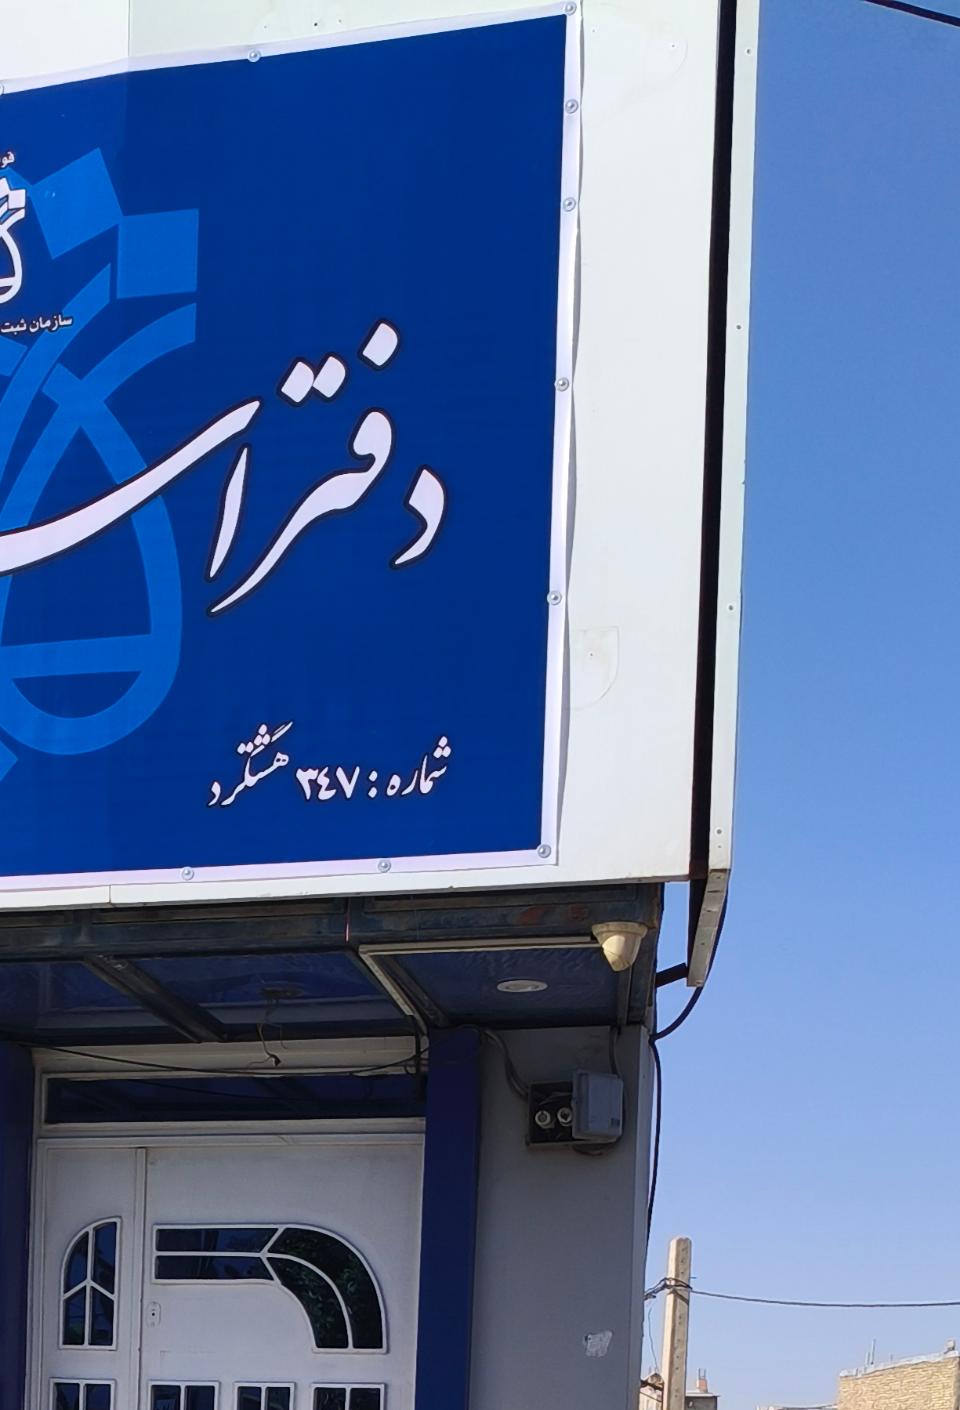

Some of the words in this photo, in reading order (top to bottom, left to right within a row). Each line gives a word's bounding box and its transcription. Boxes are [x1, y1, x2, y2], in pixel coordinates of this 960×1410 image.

[0, 318, 27, 336] ثبت
[28, 314, 73, 333] سازمان
[208, 320, 447, 615] دفتر
[207, 720, 294, 807] هشتگرد
